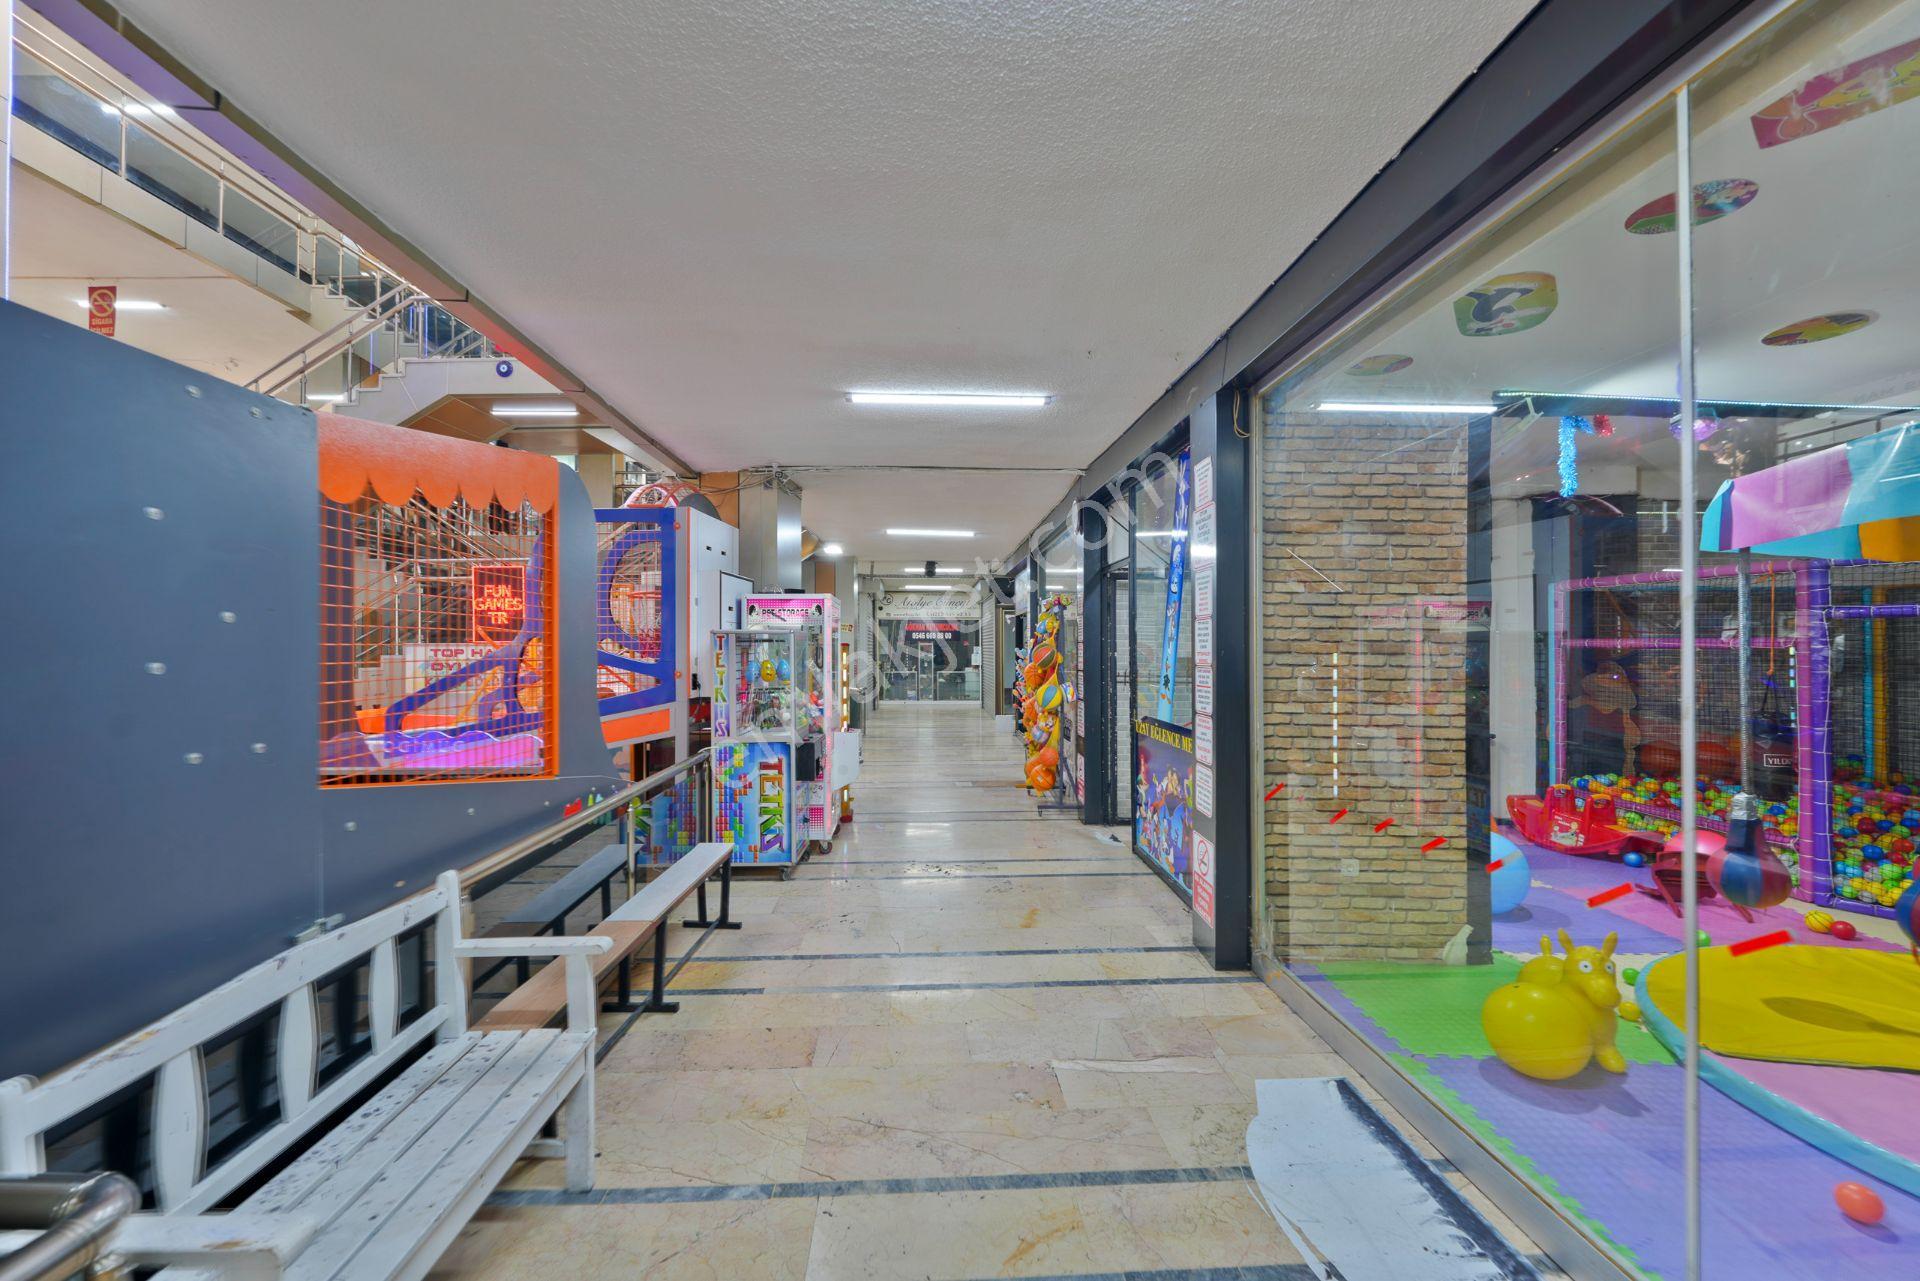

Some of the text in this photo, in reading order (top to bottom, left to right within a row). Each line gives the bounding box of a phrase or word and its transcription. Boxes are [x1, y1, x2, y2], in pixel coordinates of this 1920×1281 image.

[484, 585, 512, 597] FUN
[474, 598, 522, 611] GAMES
[488, 612, 509, 624] TR
[430, 648, 465, 657] TOP
